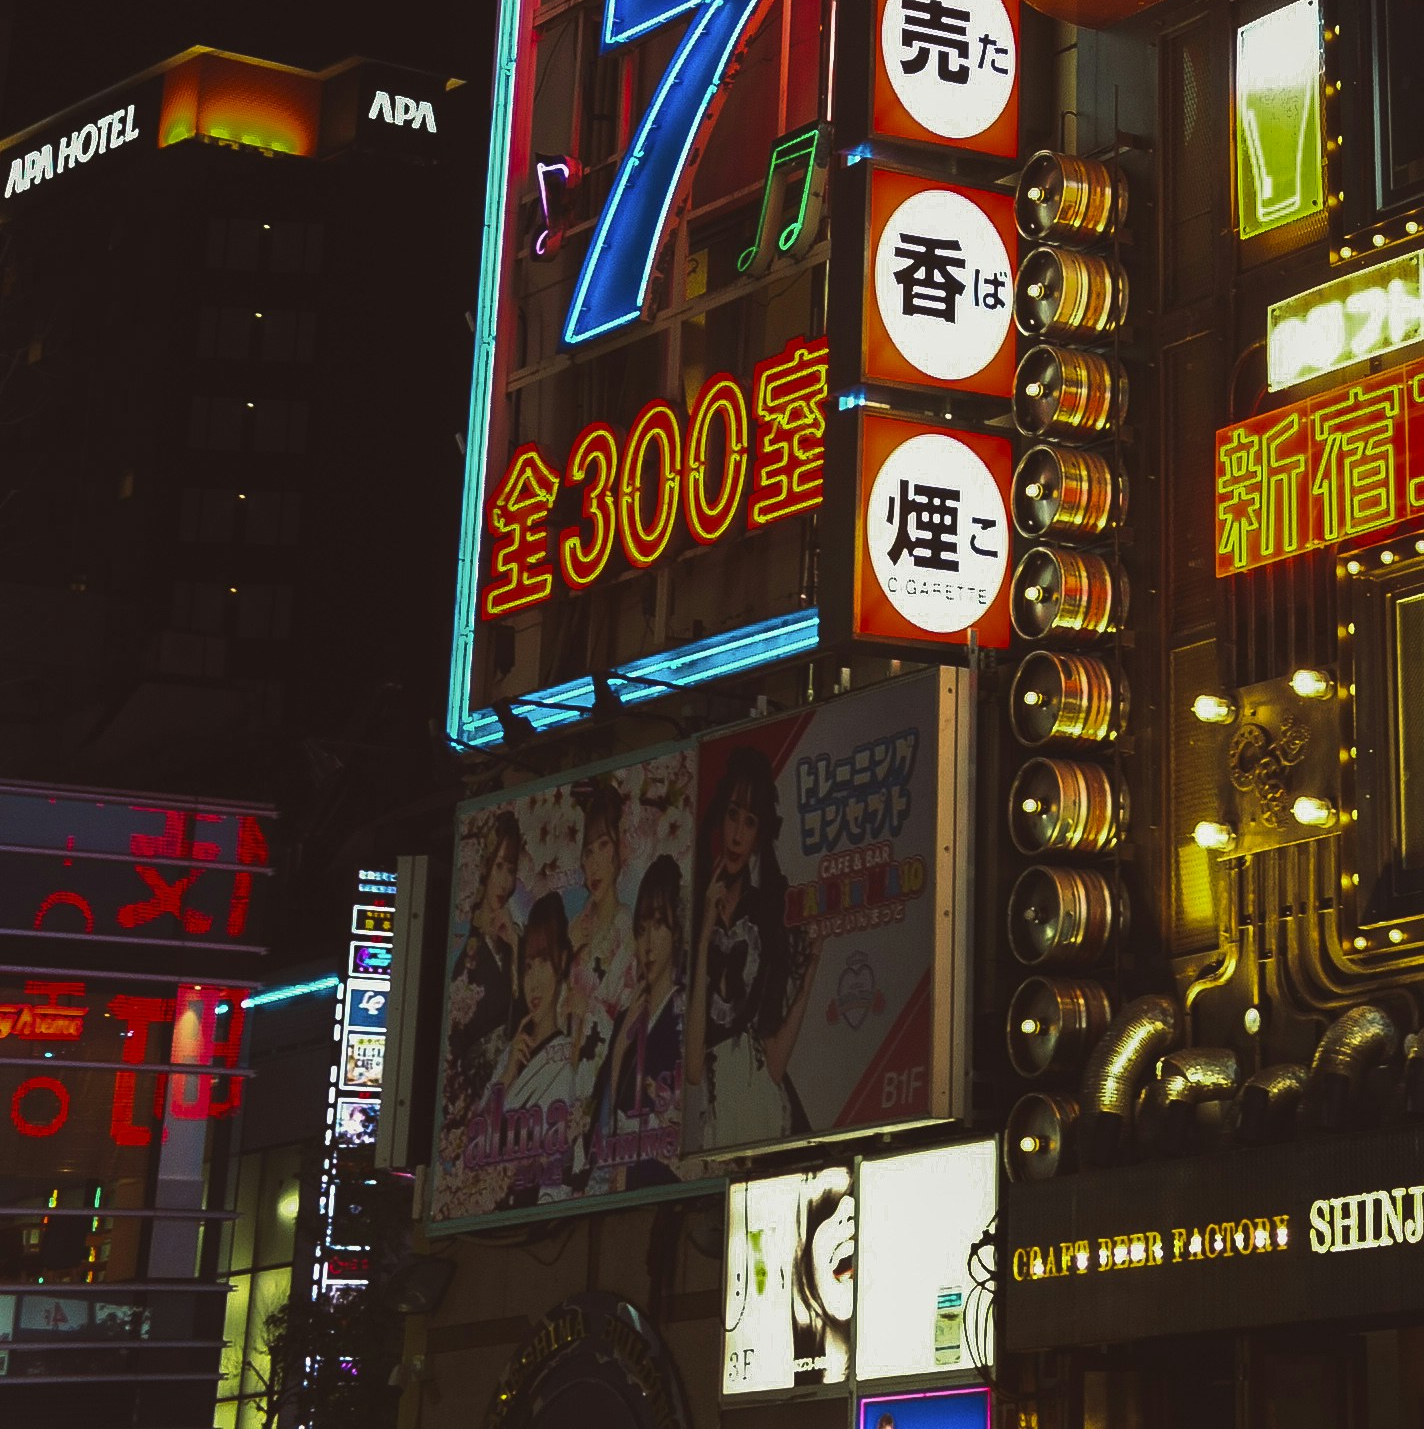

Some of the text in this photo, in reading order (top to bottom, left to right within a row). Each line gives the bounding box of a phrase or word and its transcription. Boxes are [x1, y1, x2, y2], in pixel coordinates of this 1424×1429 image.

[368, 90, 437, 134] APA
[5, 104, 140, 199] APA HOTEL
[481, 335, 829, 621] 全300室
[797, 729, 919, 807] トレーニング
[801, 785, 912, 855] コンセプト
[821, 849, 851, 879] CAFE
[866, 840, 891, 866] BAR
[880, 1066, 925, 1109] B1F
[1013, 1238, 1090, 1283] CRAFT
[1098, 1230, 1163, 1272] BEER
[1171, 1215, 1291, 1263] FACTORY
